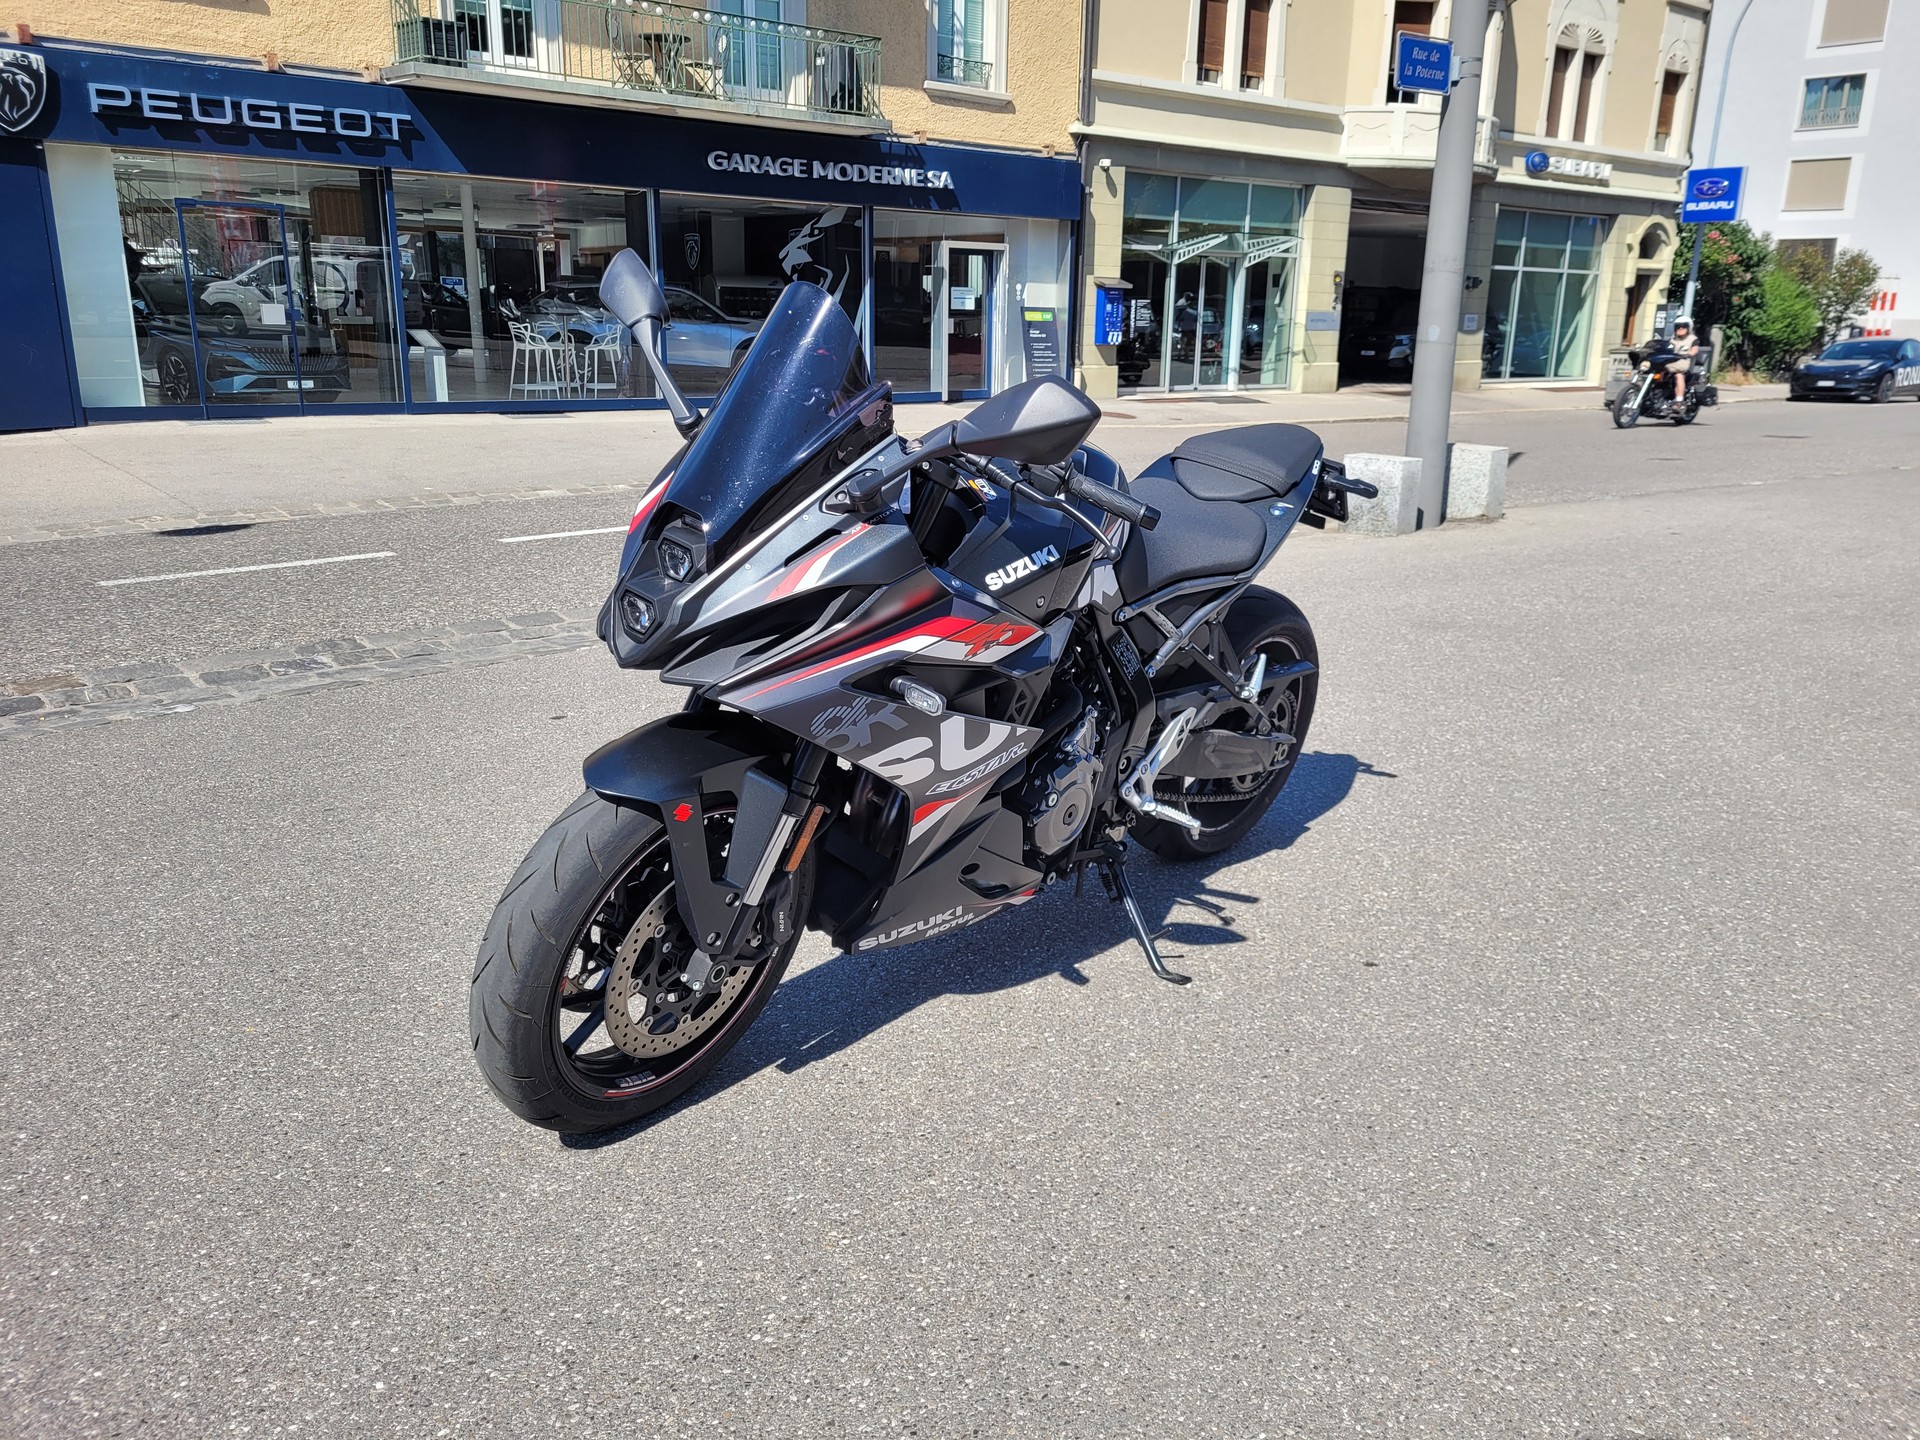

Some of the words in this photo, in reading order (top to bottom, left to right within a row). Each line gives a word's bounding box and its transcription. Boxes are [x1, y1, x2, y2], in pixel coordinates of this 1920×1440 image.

[1412, 46, 1428, 60] Rue
[1430, 49, 1440, 62] de
[1404, 62, 1413, 76] la
[1415, 65, 1445, 81] Poterne
[87, 82, 411, 141] PEUGEOT
[707, 150, 808, 178] GARAGE
[812, 160, 925, 187] MODERNE
[926, 170, 955, 190] SA
[1547, 156, 1613, 179] SUBARU
[1685, 200, 1735, 211] SUBARU
[985, 544, 1060, 591] SUZUKI
[925, 742, 1028, 796] ECSTAR
[858, 905, 963, 951] SUZUKI
[925, 912, 976, 938] MOTUL
